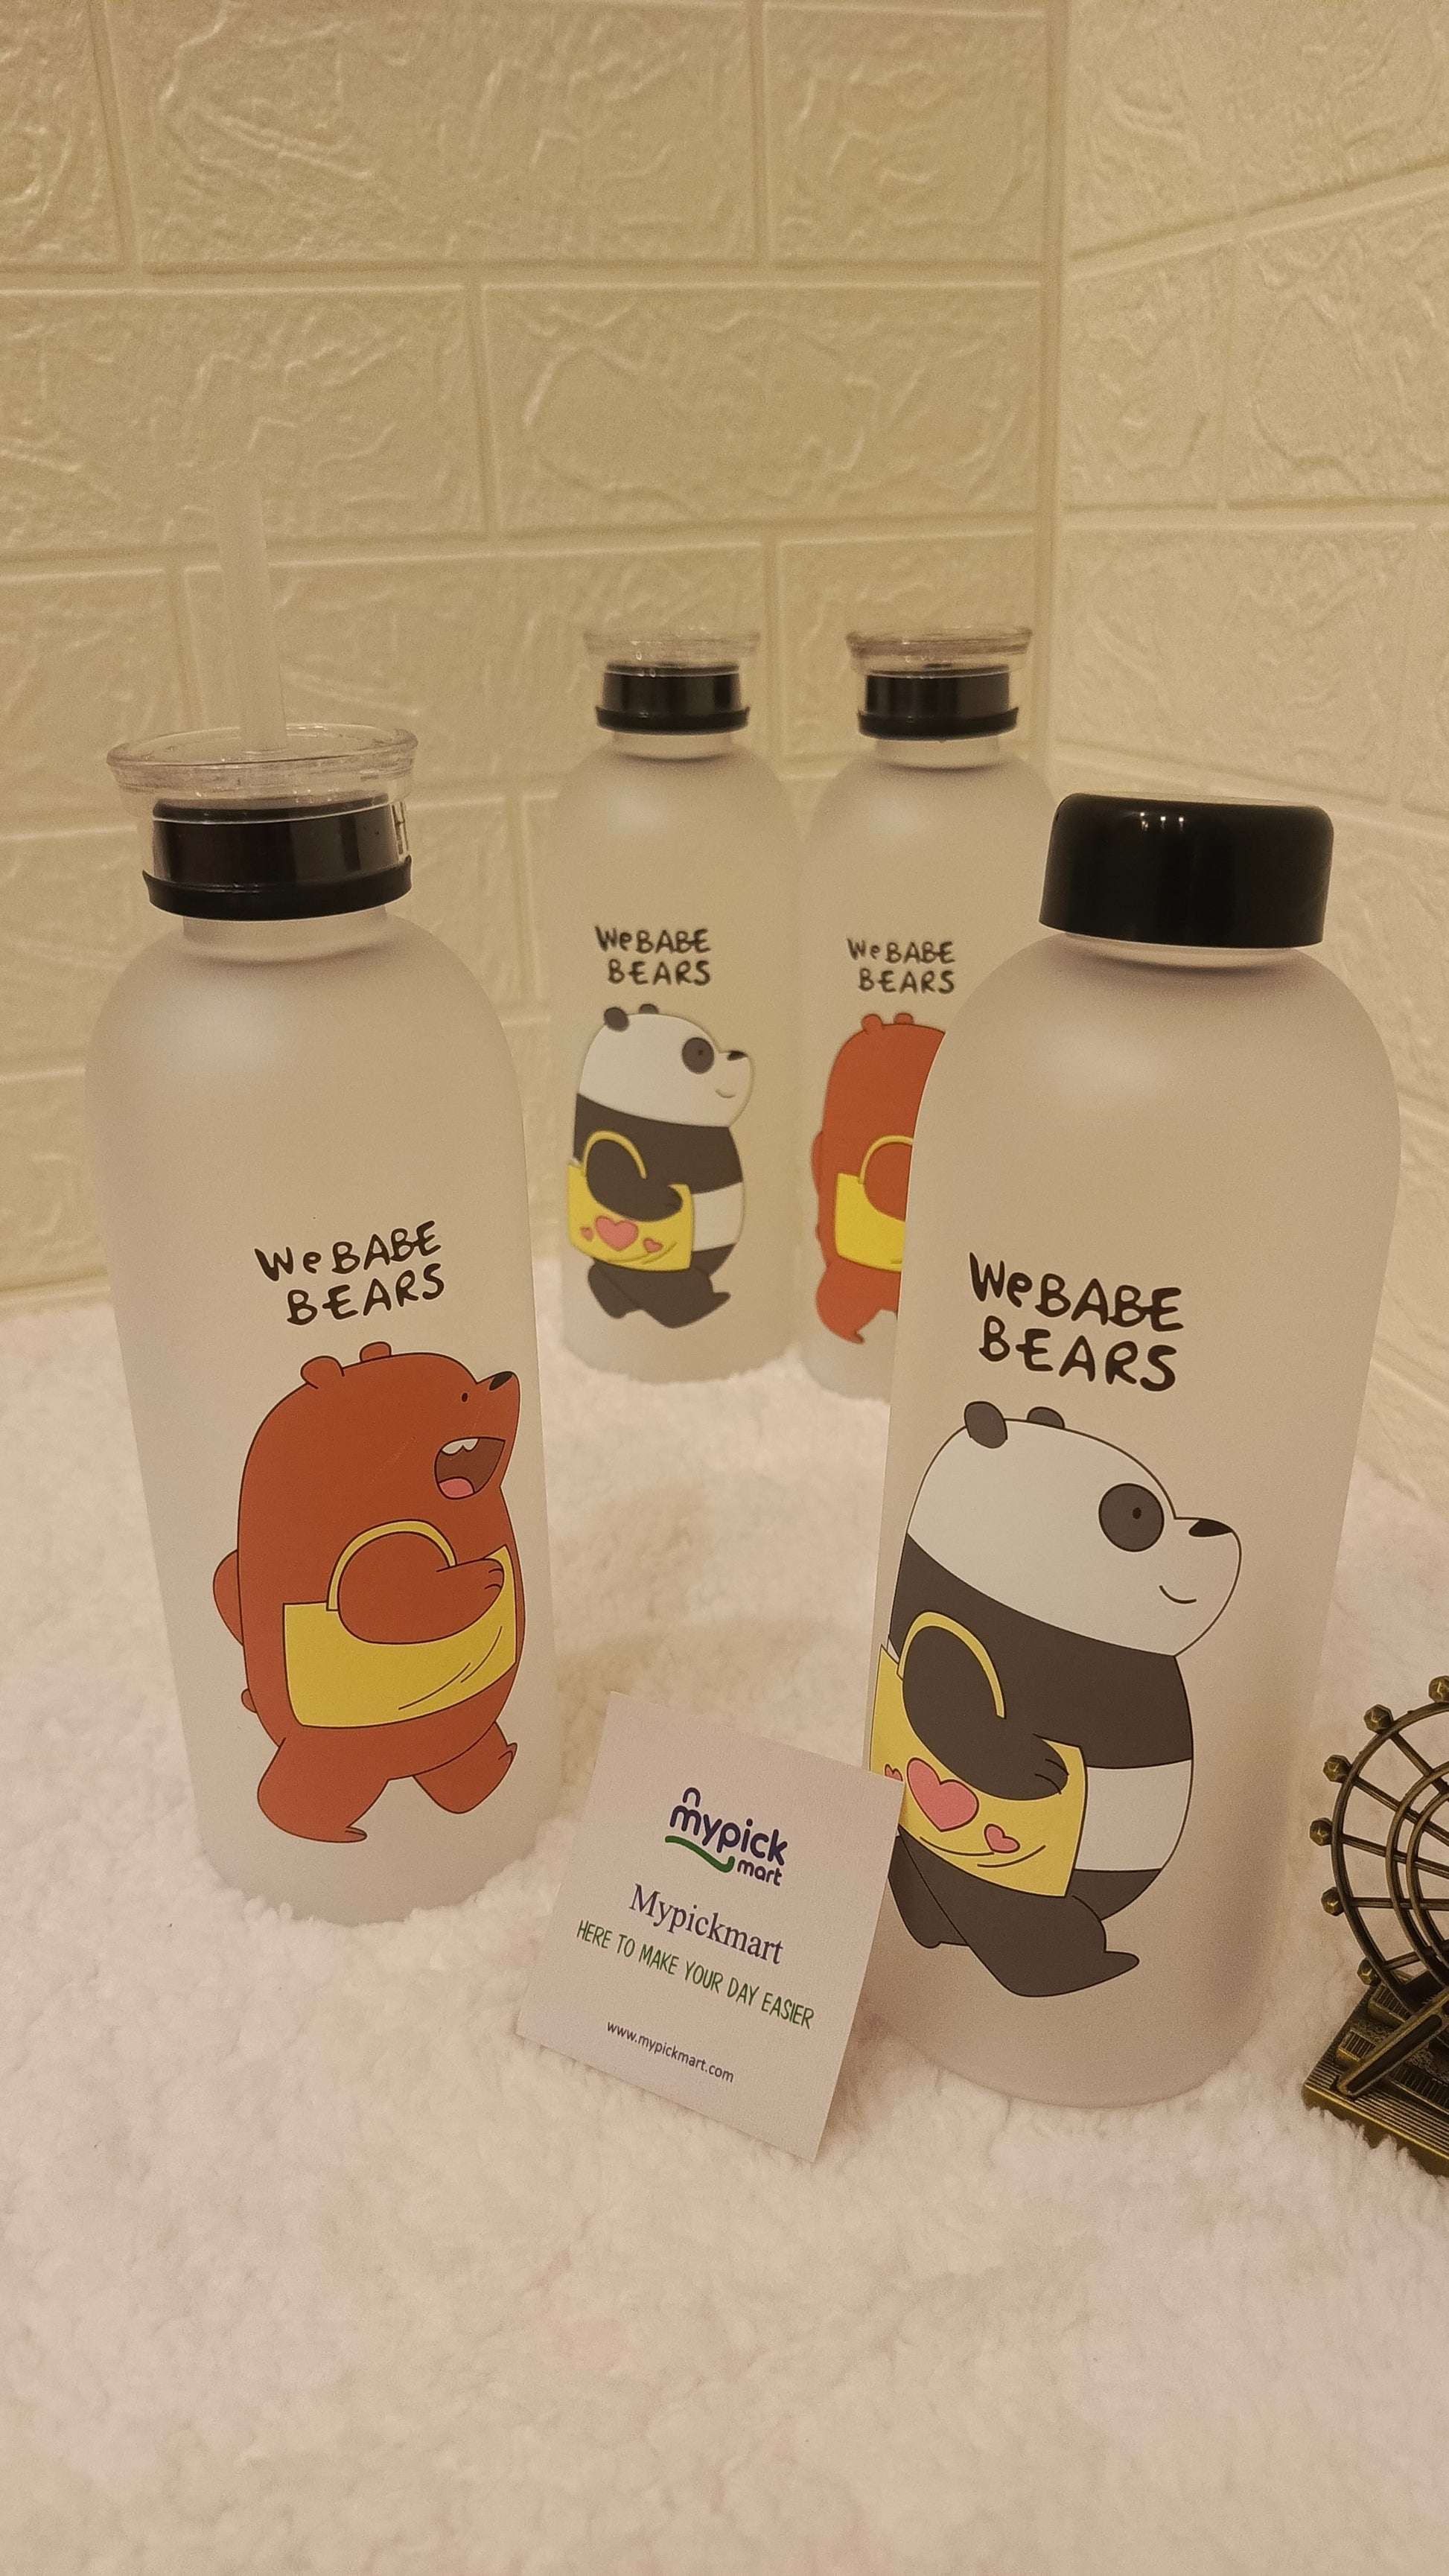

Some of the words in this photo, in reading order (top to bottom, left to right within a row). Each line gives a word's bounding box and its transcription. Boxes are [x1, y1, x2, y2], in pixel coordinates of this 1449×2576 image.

[608, 960, 711, 986] BEARS
[859, 969, 955, 994] BEARS
[287, 1263, 445, 1326] BEARS
[978, 1315, 1177, 1391] BEARS
[670, 1805, 788, 1866] mypick
[737, 1860, 783, 1887] mart
[628, 1884, 784, 1964] Mypickmart
[576, 1919, 611, 1948] HERE
[618, 1933, 635, 1958] TO
[638, 1943, 679, 1975] MAKE
[685, 1960, 724, 1993] YOUR
[727, 1977, 760, 2006] DAY
[761, 1992, 815, 2030] EASIER
[606, 2021, 735, 2083] www.mypickmart.com
